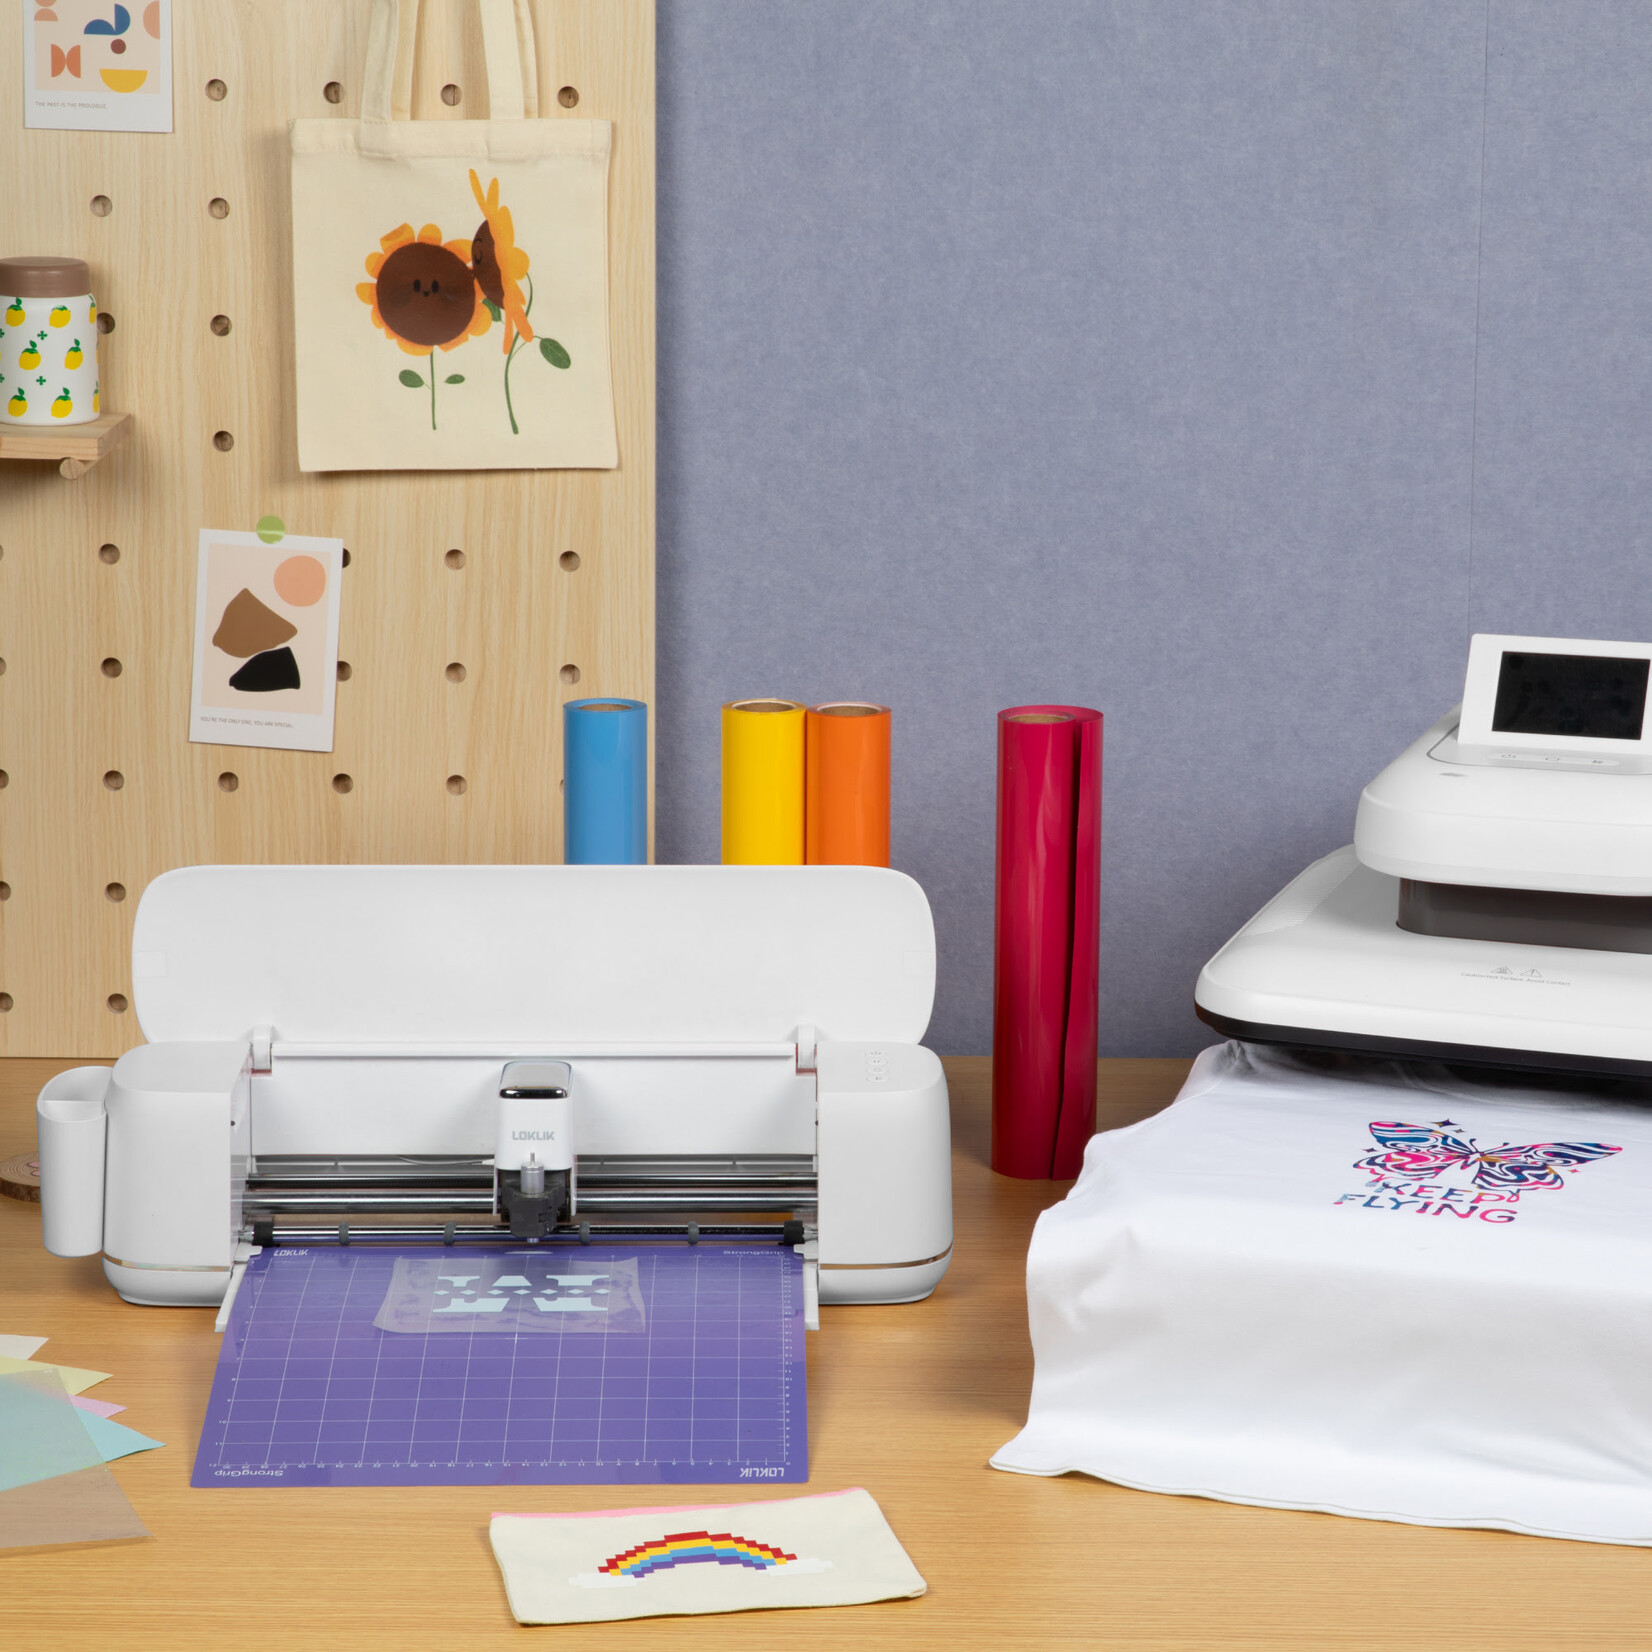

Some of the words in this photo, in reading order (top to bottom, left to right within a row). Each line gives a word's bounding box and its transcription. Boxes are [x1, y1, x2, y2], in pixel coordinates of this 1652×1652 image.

[512, 1130, 555, 1141] LOKLIK
[1373, 1181, 1506, 1204] KEEP
[1333, 1193, 1517, 1224] FLYING
[273, 1249, 309, 1257] LOKLIK
[214, 1469, 284, 1477] StrongGrip
[739, 1467, 785, 1478] LOKLIK
